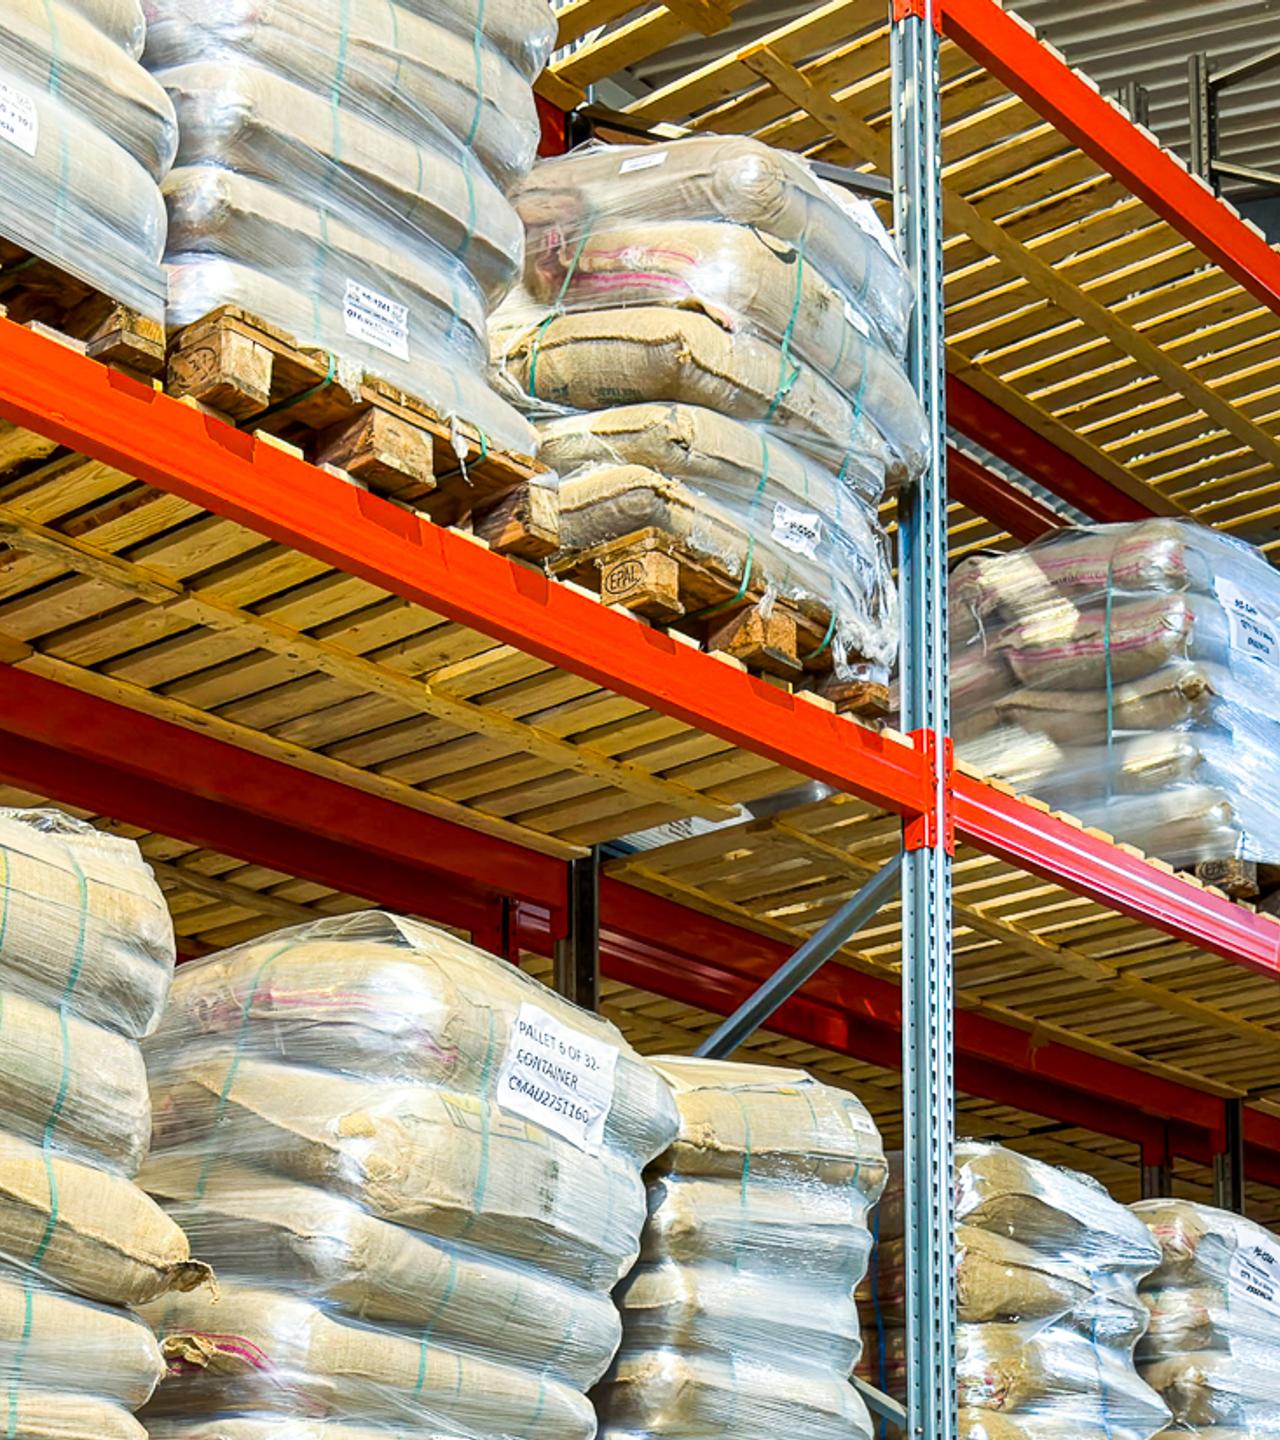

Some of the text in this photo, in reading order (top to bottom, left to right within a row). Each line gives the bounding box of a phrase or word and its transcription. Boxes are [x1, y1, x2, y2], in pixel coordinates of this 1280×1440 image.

[608, 564, 641, 589] EPAL
[519, 1021, 556, 1050] PALLET
[559, 1042, 566, 1055] 6
[568, 1046, 581, 1061] OF
[516, 1048, 578, 1090] CONTAINER
[508, 1075, 590, 1124] CMAU2751160
